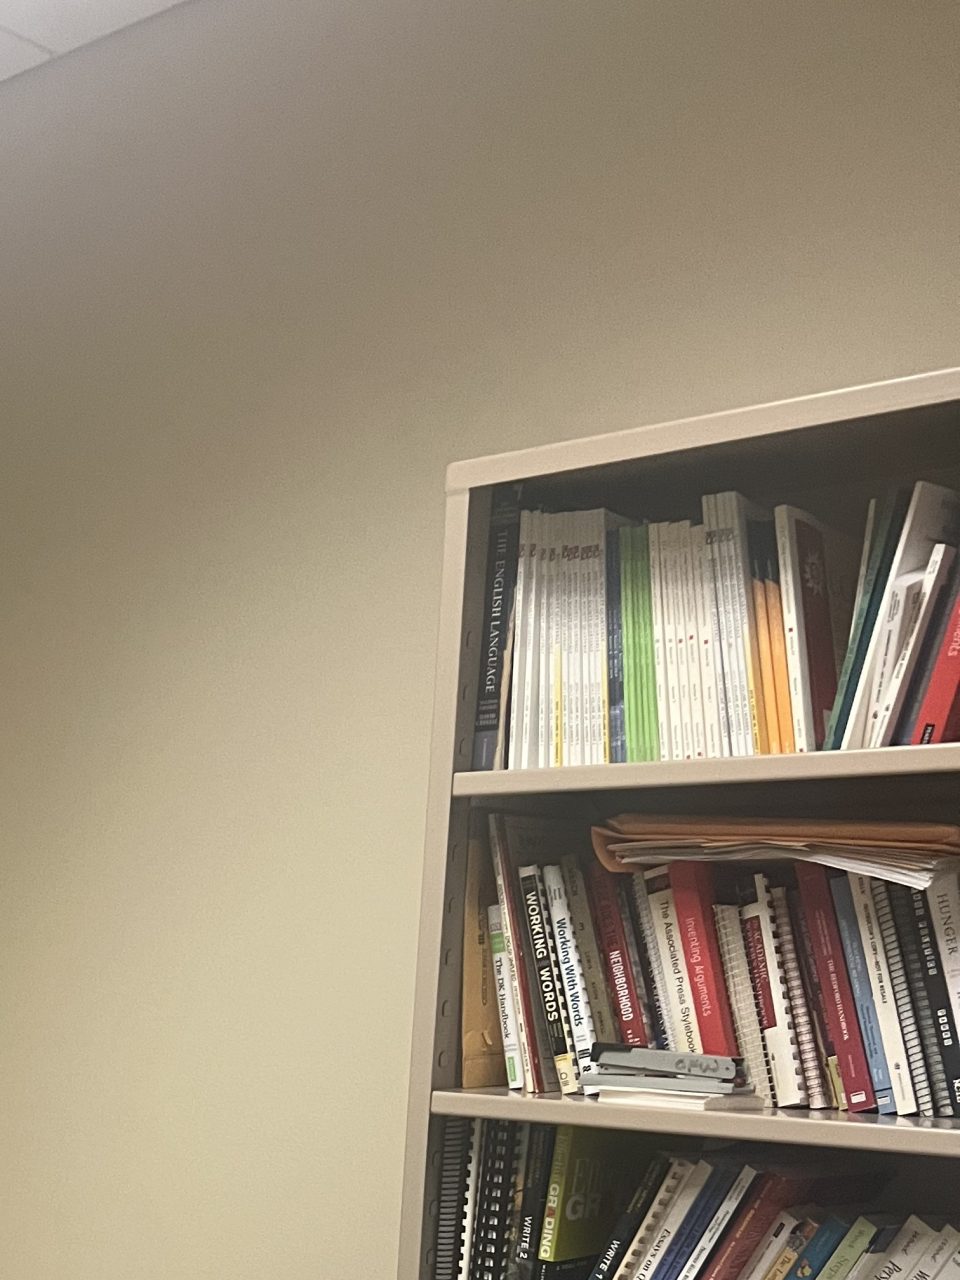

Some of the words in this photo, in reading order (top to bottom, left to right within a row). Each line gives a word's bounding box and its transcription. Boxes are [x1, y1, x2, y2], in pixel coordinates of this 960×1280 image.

[497, 530, 508, 554] THE
[490, 560, 506, 617] ENGLISH
[485, 620, 501, 693] LANGUAGE
[659, 900, 669, 920] The
[937, 893, 958, 955] HUNGER
[523, 890, 550, 958] WORKING
[538, 967, 562, 1021] WORDS
[555, 917, 574, 964] Working
[663, 924, 680, 974] Associated
[684, 917, 700, 965] Inventing
[751, 930, 769, 982] ACADEMIC
[495, 957, 505, 975] The
[498, 977, 505, 990] DK
[565, 963, 579, 990] With
[607, 949, 638, 1021] NEIGHBORHOOD
[570, 991, 586, 1026] Words
[673, 979, 684, 1006] Press
[690, 966, 712, 1016] Arguments
[498, 993, 513, 1038] Handbook
[680, 1005, 696, 1053] Stylebook
[522, 1215, 533, 1248] WRITE
[540, 1183, 561, 1258] GRADING
[599, 1238, 621, 1271] WRITE
[643, 1259, 654, 1272] on
[649, 1227, 672, 1260] Essays
[595, 1272, 604, 1280] 1
